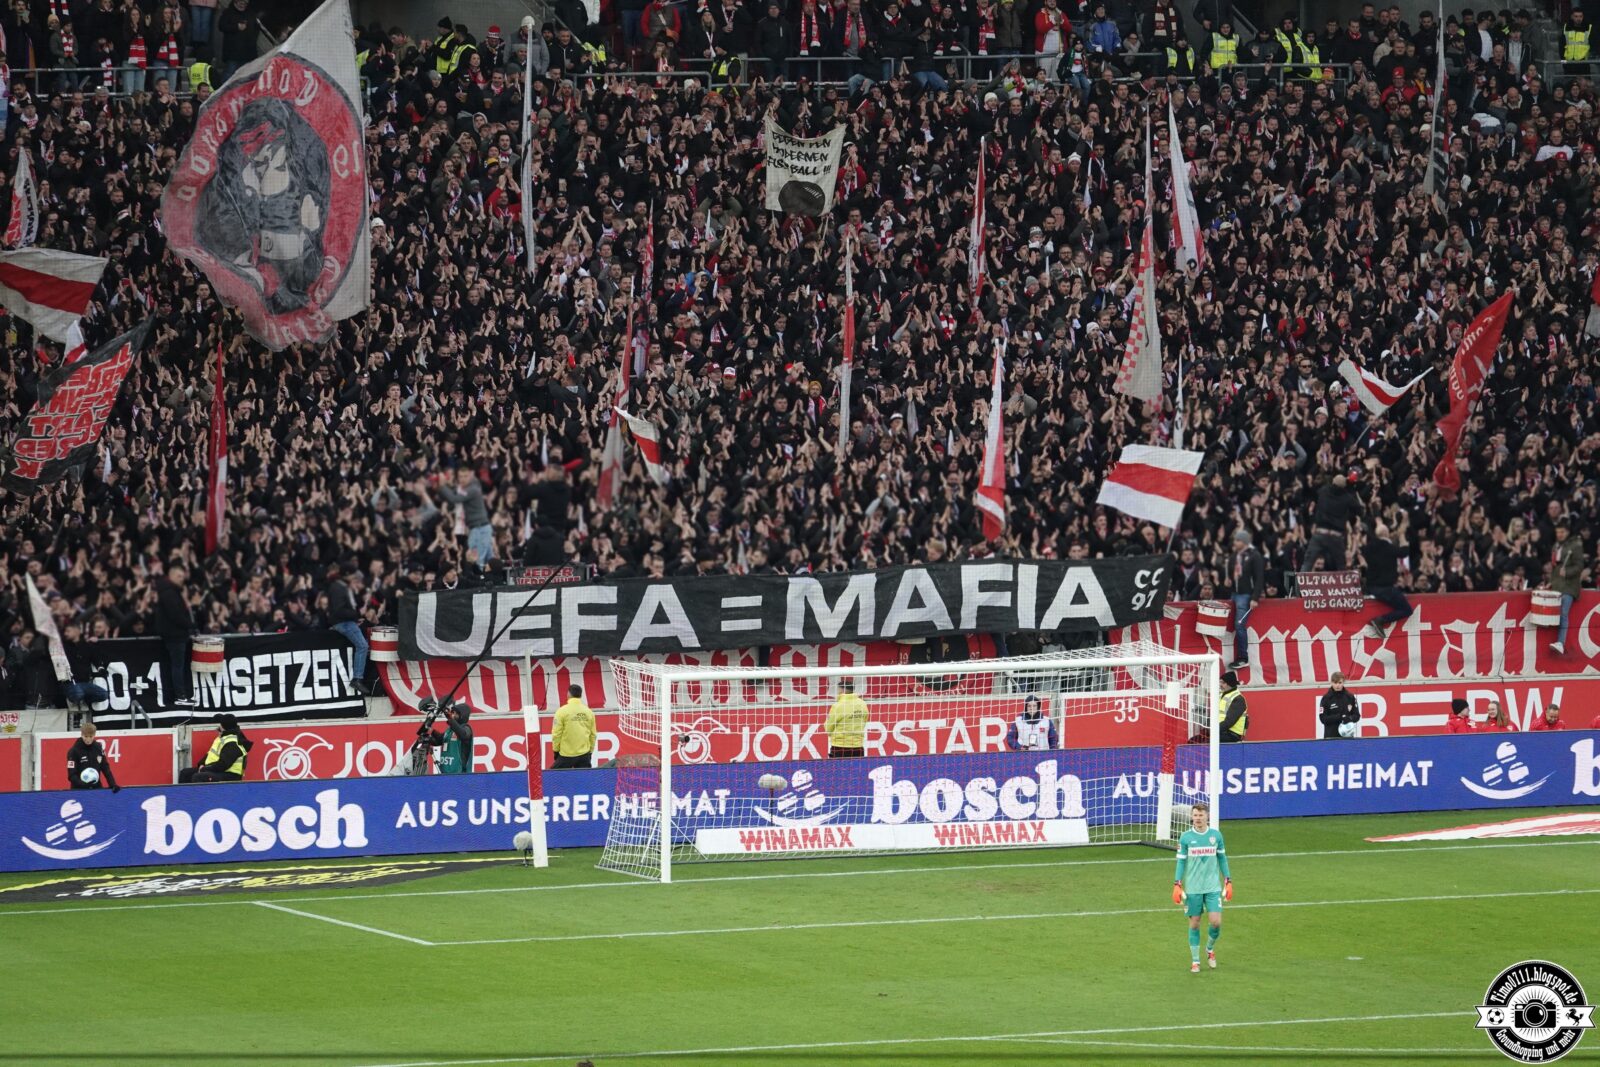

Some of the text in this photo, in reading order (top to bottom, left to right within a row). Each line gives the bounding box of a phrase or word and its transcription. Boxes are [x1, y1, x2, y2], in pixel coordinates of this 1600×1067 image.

[1134, 567, 1164, 589] CC
[1131, 590, 1157, 611] 97
[1300, 586, 1361, 597] DER KAMPF
[1303, 598, 1364, 610] UMS GANZE
[415, 563, 1116, 657] UEFA = MAFIA
[1114, 699, 1140, 724] 35
[730, 717, 1008, 762] JOKRSTAR
[868, 759, 1086, 824] bosch
[1112, 771, 1163, 799] AU
[1327, 760, 1433, 790] HEIMAT
[396, 800, 459, 828] AUS
[620, 789, 731, 819] HEMAT
[140, 788, 368, 856] bosch
[933, 821, 1047, 846] WINAMAX
[739, 826, 855, 851] WINAMAX
